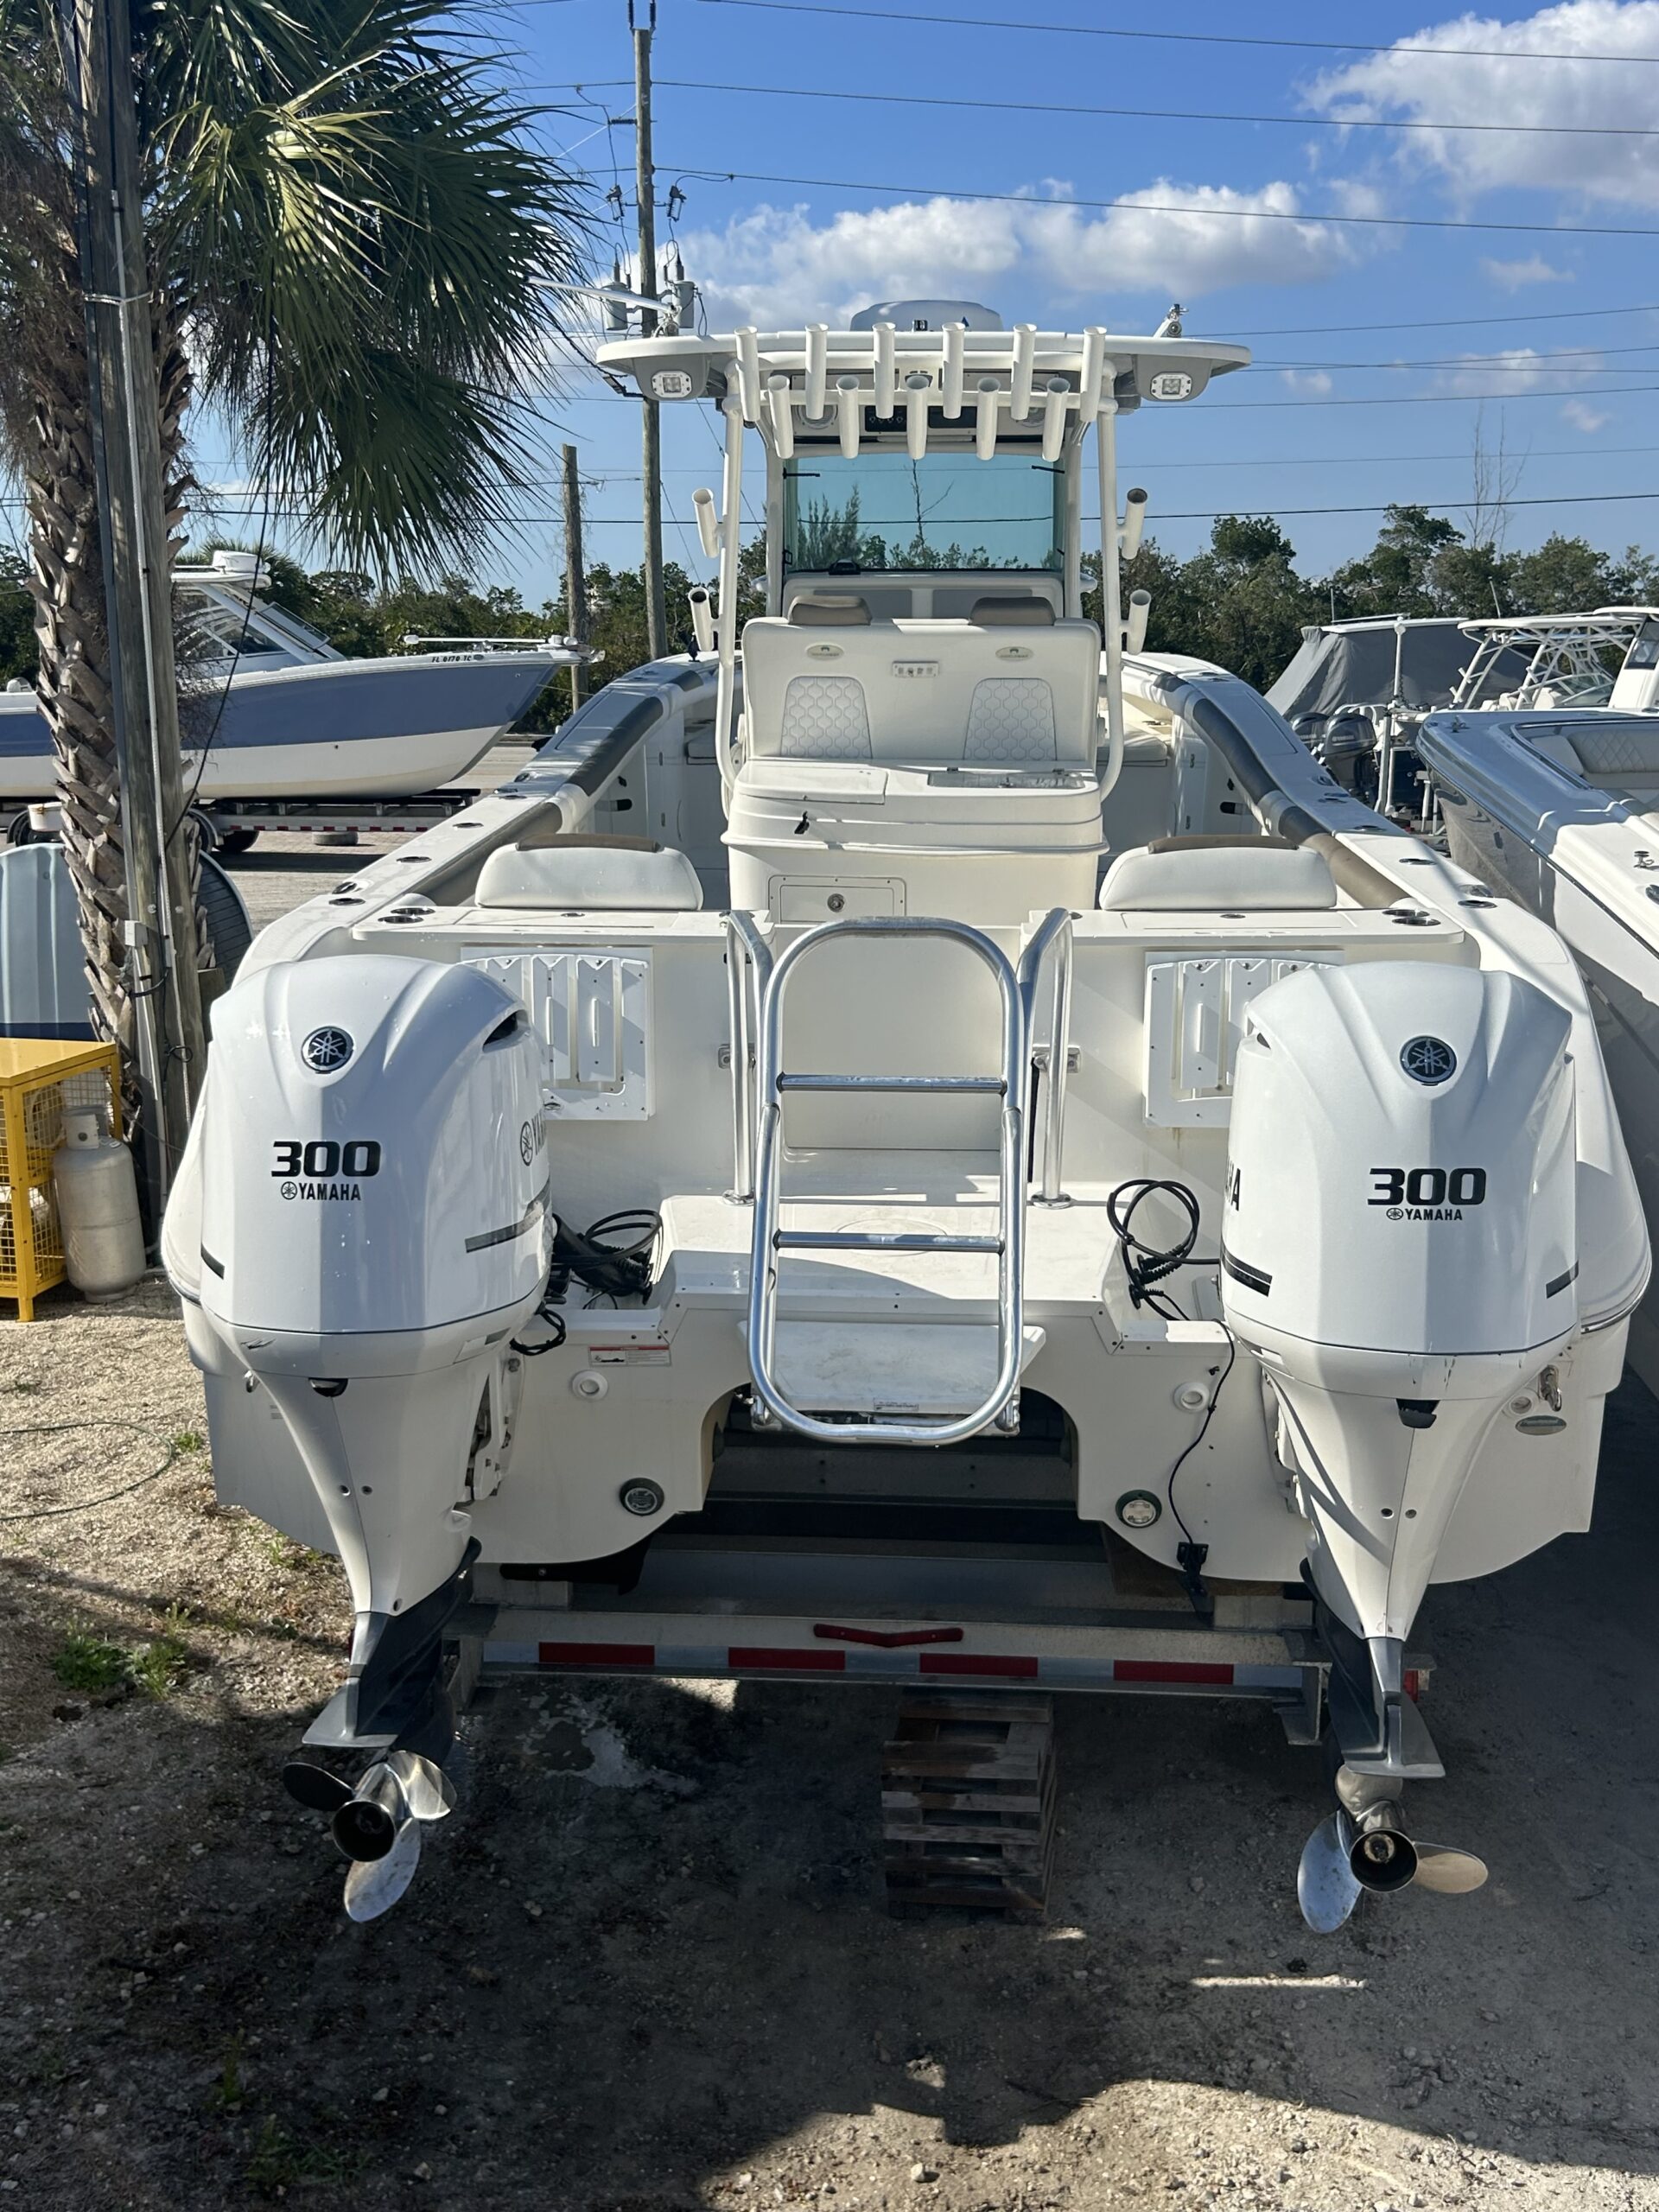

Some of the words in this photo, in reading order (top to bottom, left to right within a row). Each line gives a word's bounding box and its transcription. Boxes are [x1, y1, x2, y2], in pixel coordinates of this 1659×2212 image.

[271, 1141, 381, 1177] 300
[298, 1182, 361, 1201] YAMAHA
[1367, 1168, 1486, 1205] 300
[1404, 1208, 1463, 1221] YAMAHA
